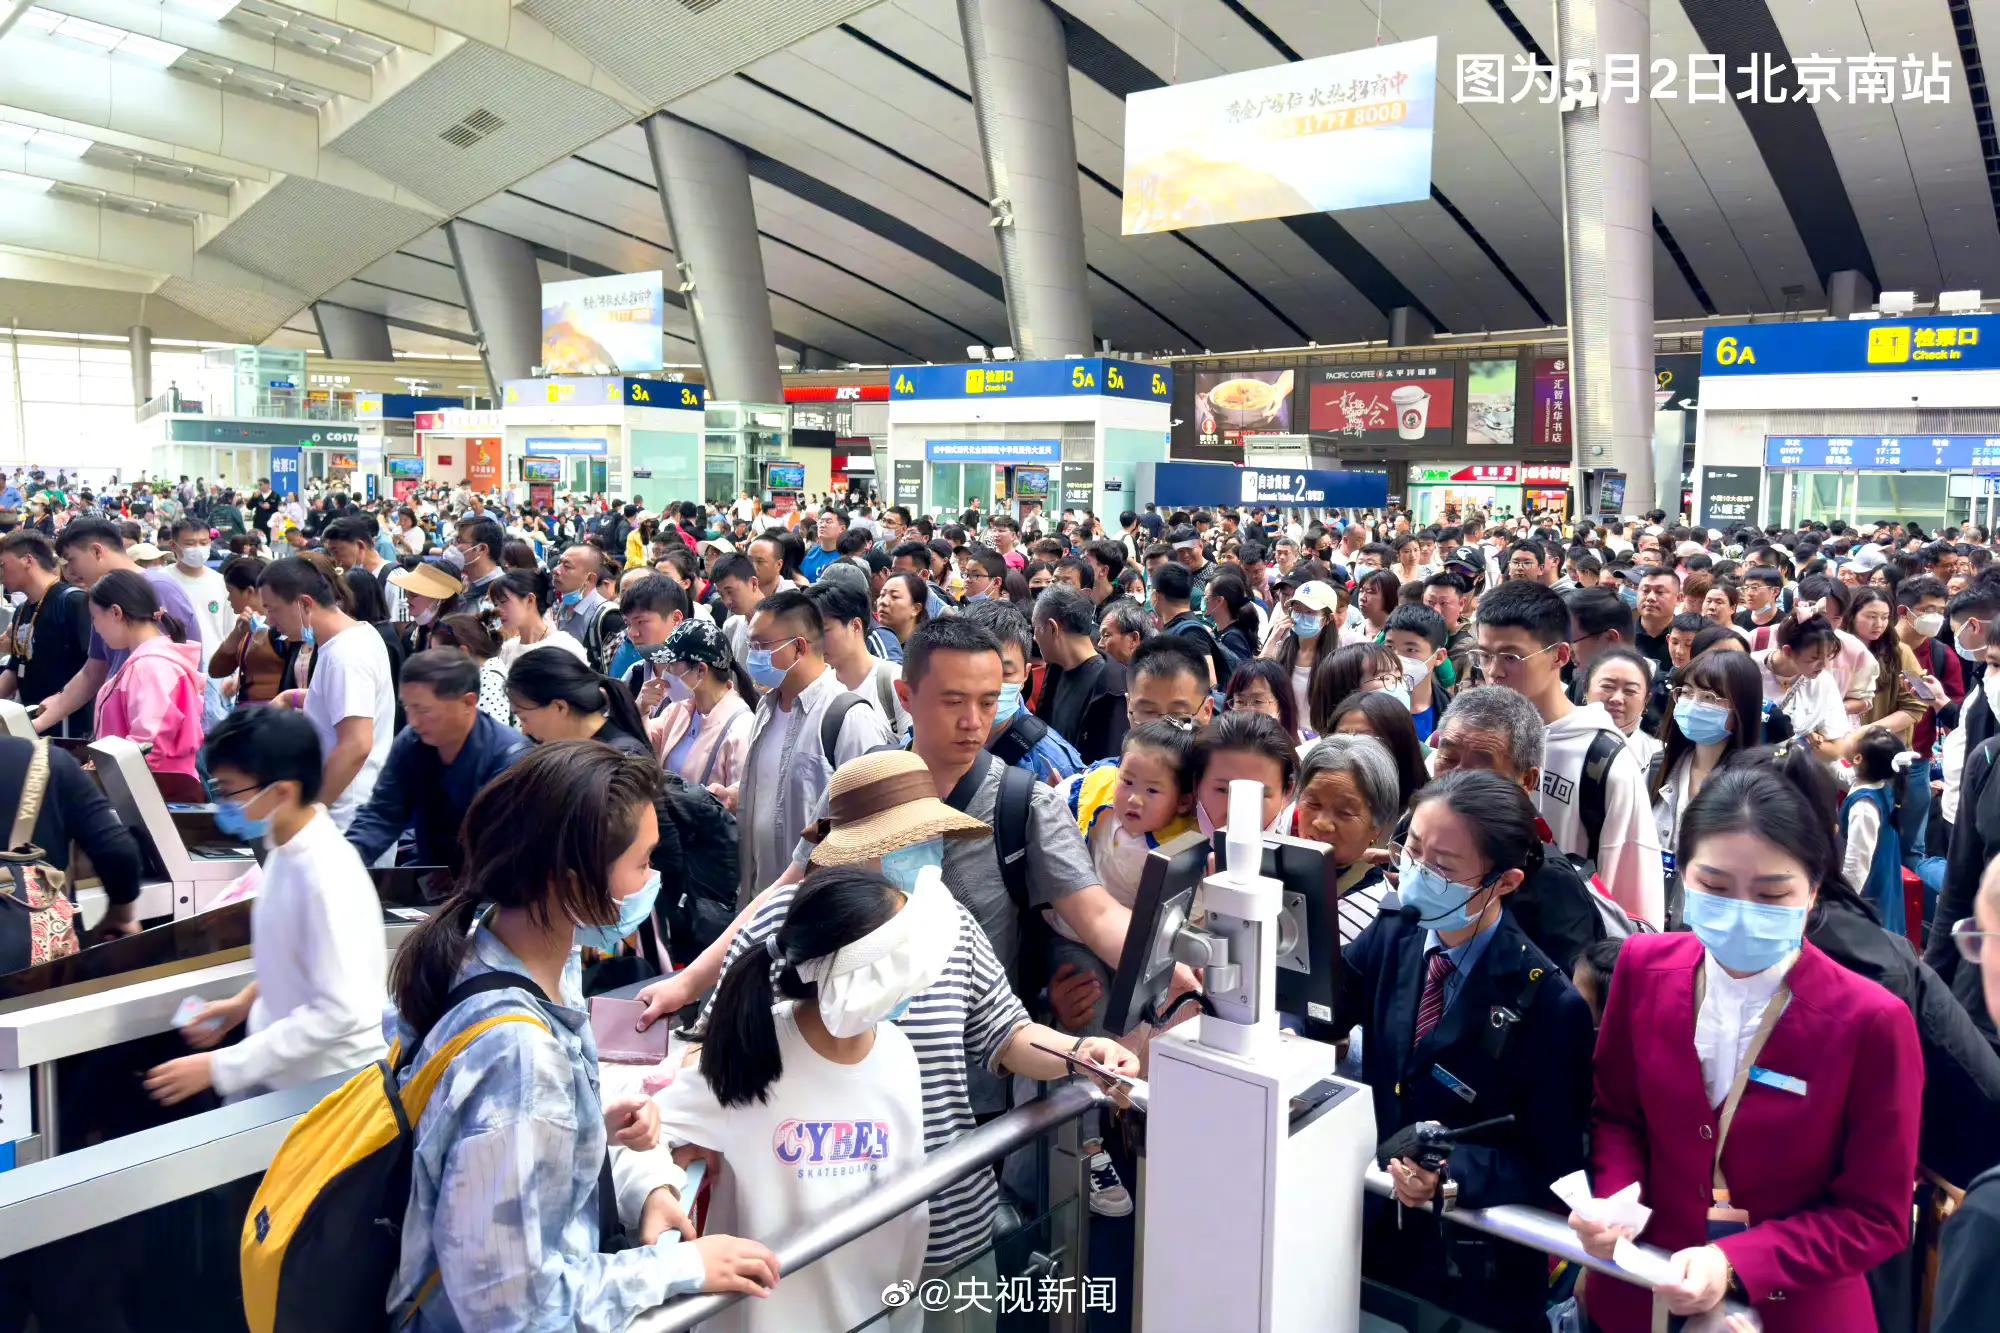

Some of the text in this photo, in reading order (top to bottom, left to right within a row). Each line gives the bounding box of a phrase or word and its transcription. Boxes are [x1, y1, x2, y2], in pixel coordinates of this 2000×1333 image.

[1354, 101, 1402, 126] 8008
[1914, 327, 1979, 347] 检票口
[1715, 336, 1757, 366] 6A
[1912, 350, 1961, 361] Check in
[894, 373, 915, 395] 4A
[1071, 366, 1095, 389] 5A
[1107, 366, 1125, 390] 5A
[1151, 373, 1167, 396] 5A
[1325, 370, 1376, 380] PACIFIC COFFEE
[631, 383, 650, 402] 3A
[680, 387, 699, 406] 3A
[1551, 378, 1565, 443] 汇智光华书店
[272, 457, 298, 474] 检票口
[281, 475, 288, 491] 1
[1295, 474, 1306, 502] 2
[773, 1119, 890, 1165] CYBER
[797, 1163, 877, 1180] SKATEBOARD
